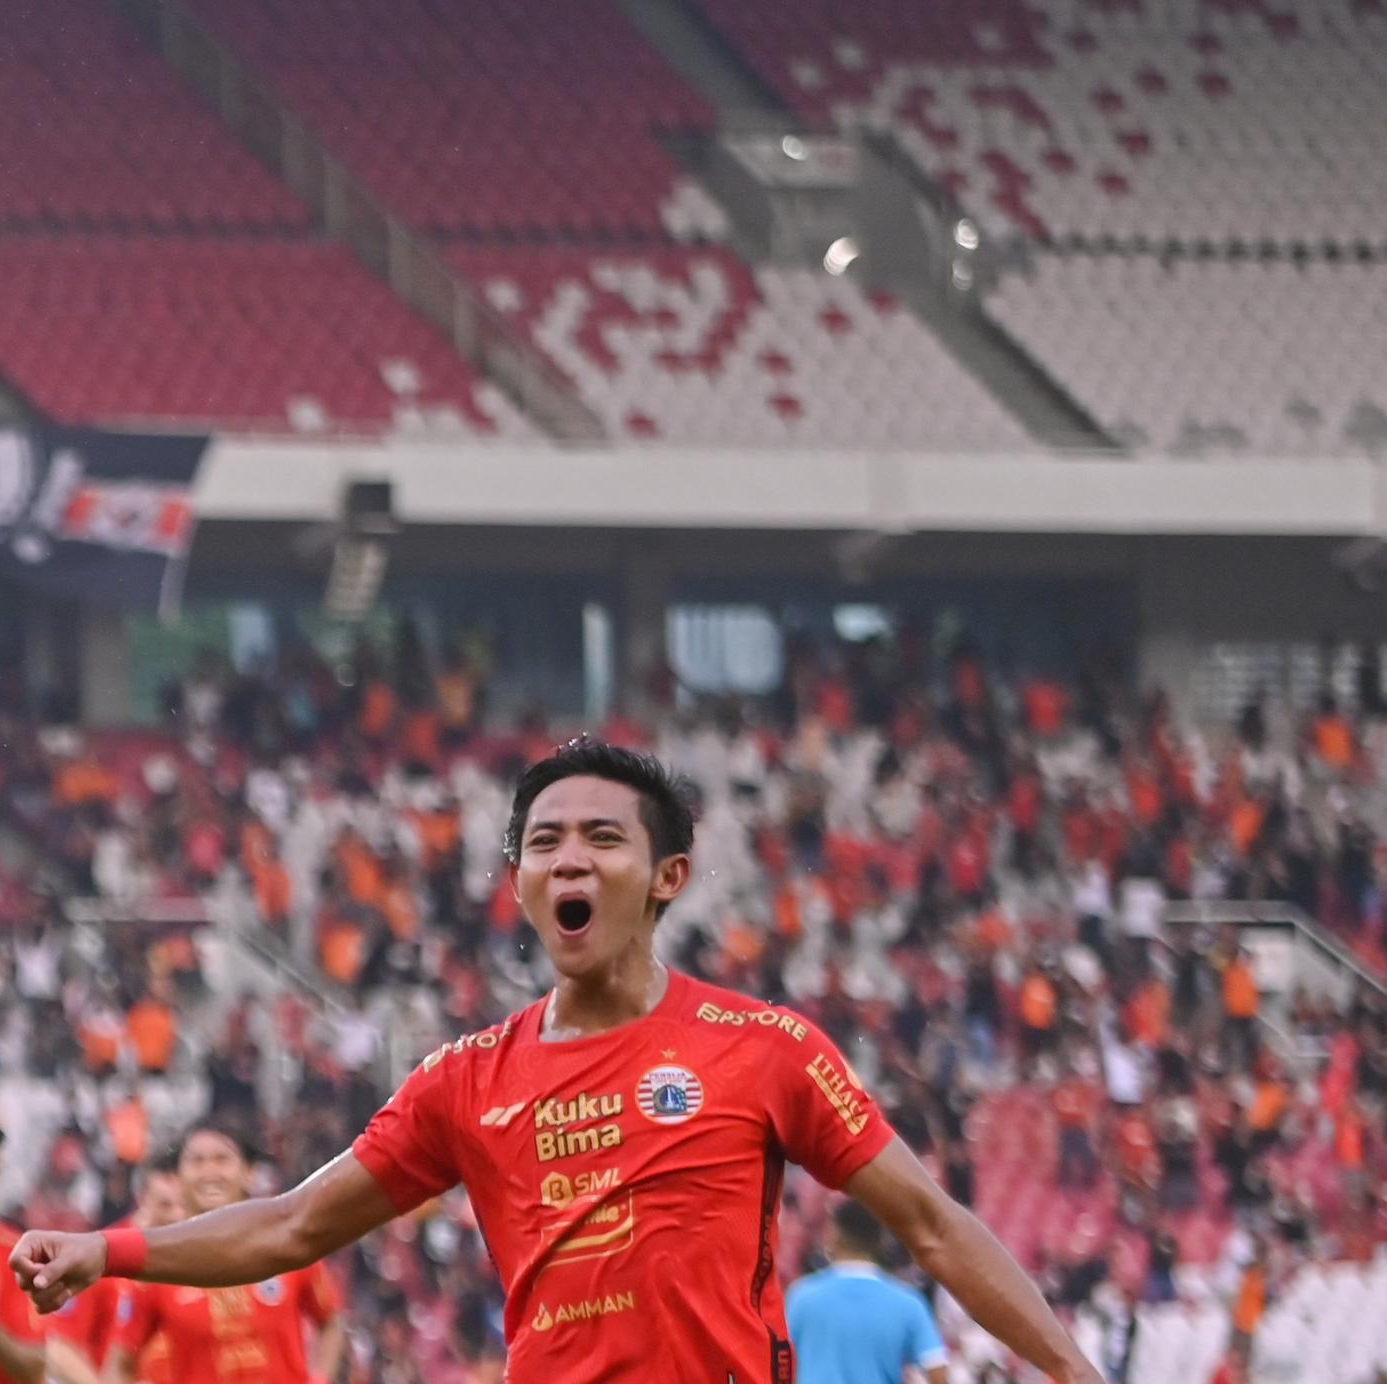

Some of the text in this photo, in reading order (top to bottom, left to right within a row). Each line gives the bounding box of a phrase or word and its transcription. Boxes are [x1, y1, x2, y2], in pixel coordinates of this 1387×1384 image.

[719, 1008, 809, 1042] PSTORE
[812, 1052, 870, 1131] ITHACA
[532, 1091, 623, 1130] Kuku
[534, 1123, 622, 1163] Bima
[573, 1166, 624, 1195] SML
[554, 1290, 635, 1323] AMMAN
